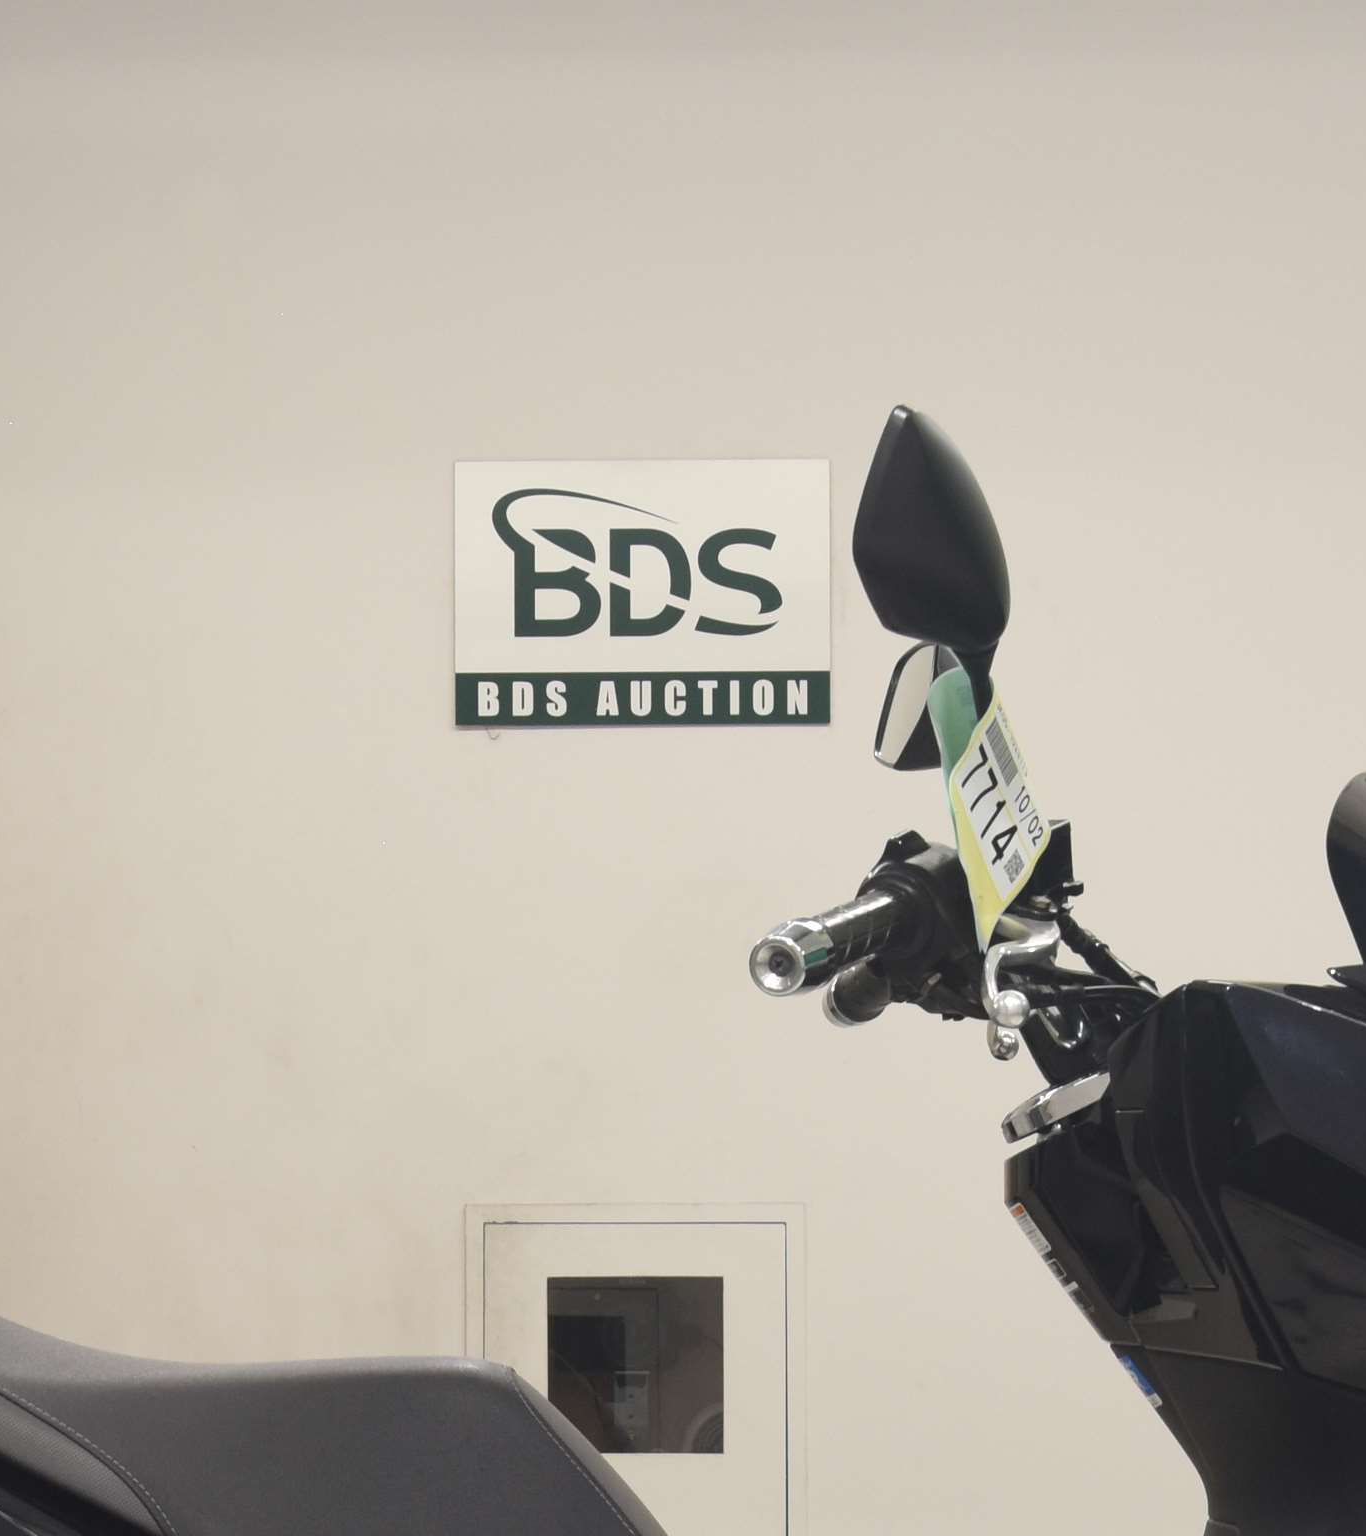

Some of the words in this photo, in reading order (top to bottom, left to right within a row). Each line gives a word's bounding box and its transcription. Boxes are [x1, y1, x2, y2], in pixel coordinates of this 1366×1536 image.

[492, 488, 782, 637] BDS
[477, 680, 567, 717] BDS
[596, 679, 809, 716] AUCTION
[961, 743, 1018, 866] 7714
[1014, 785, 1044, 847] 10/02
